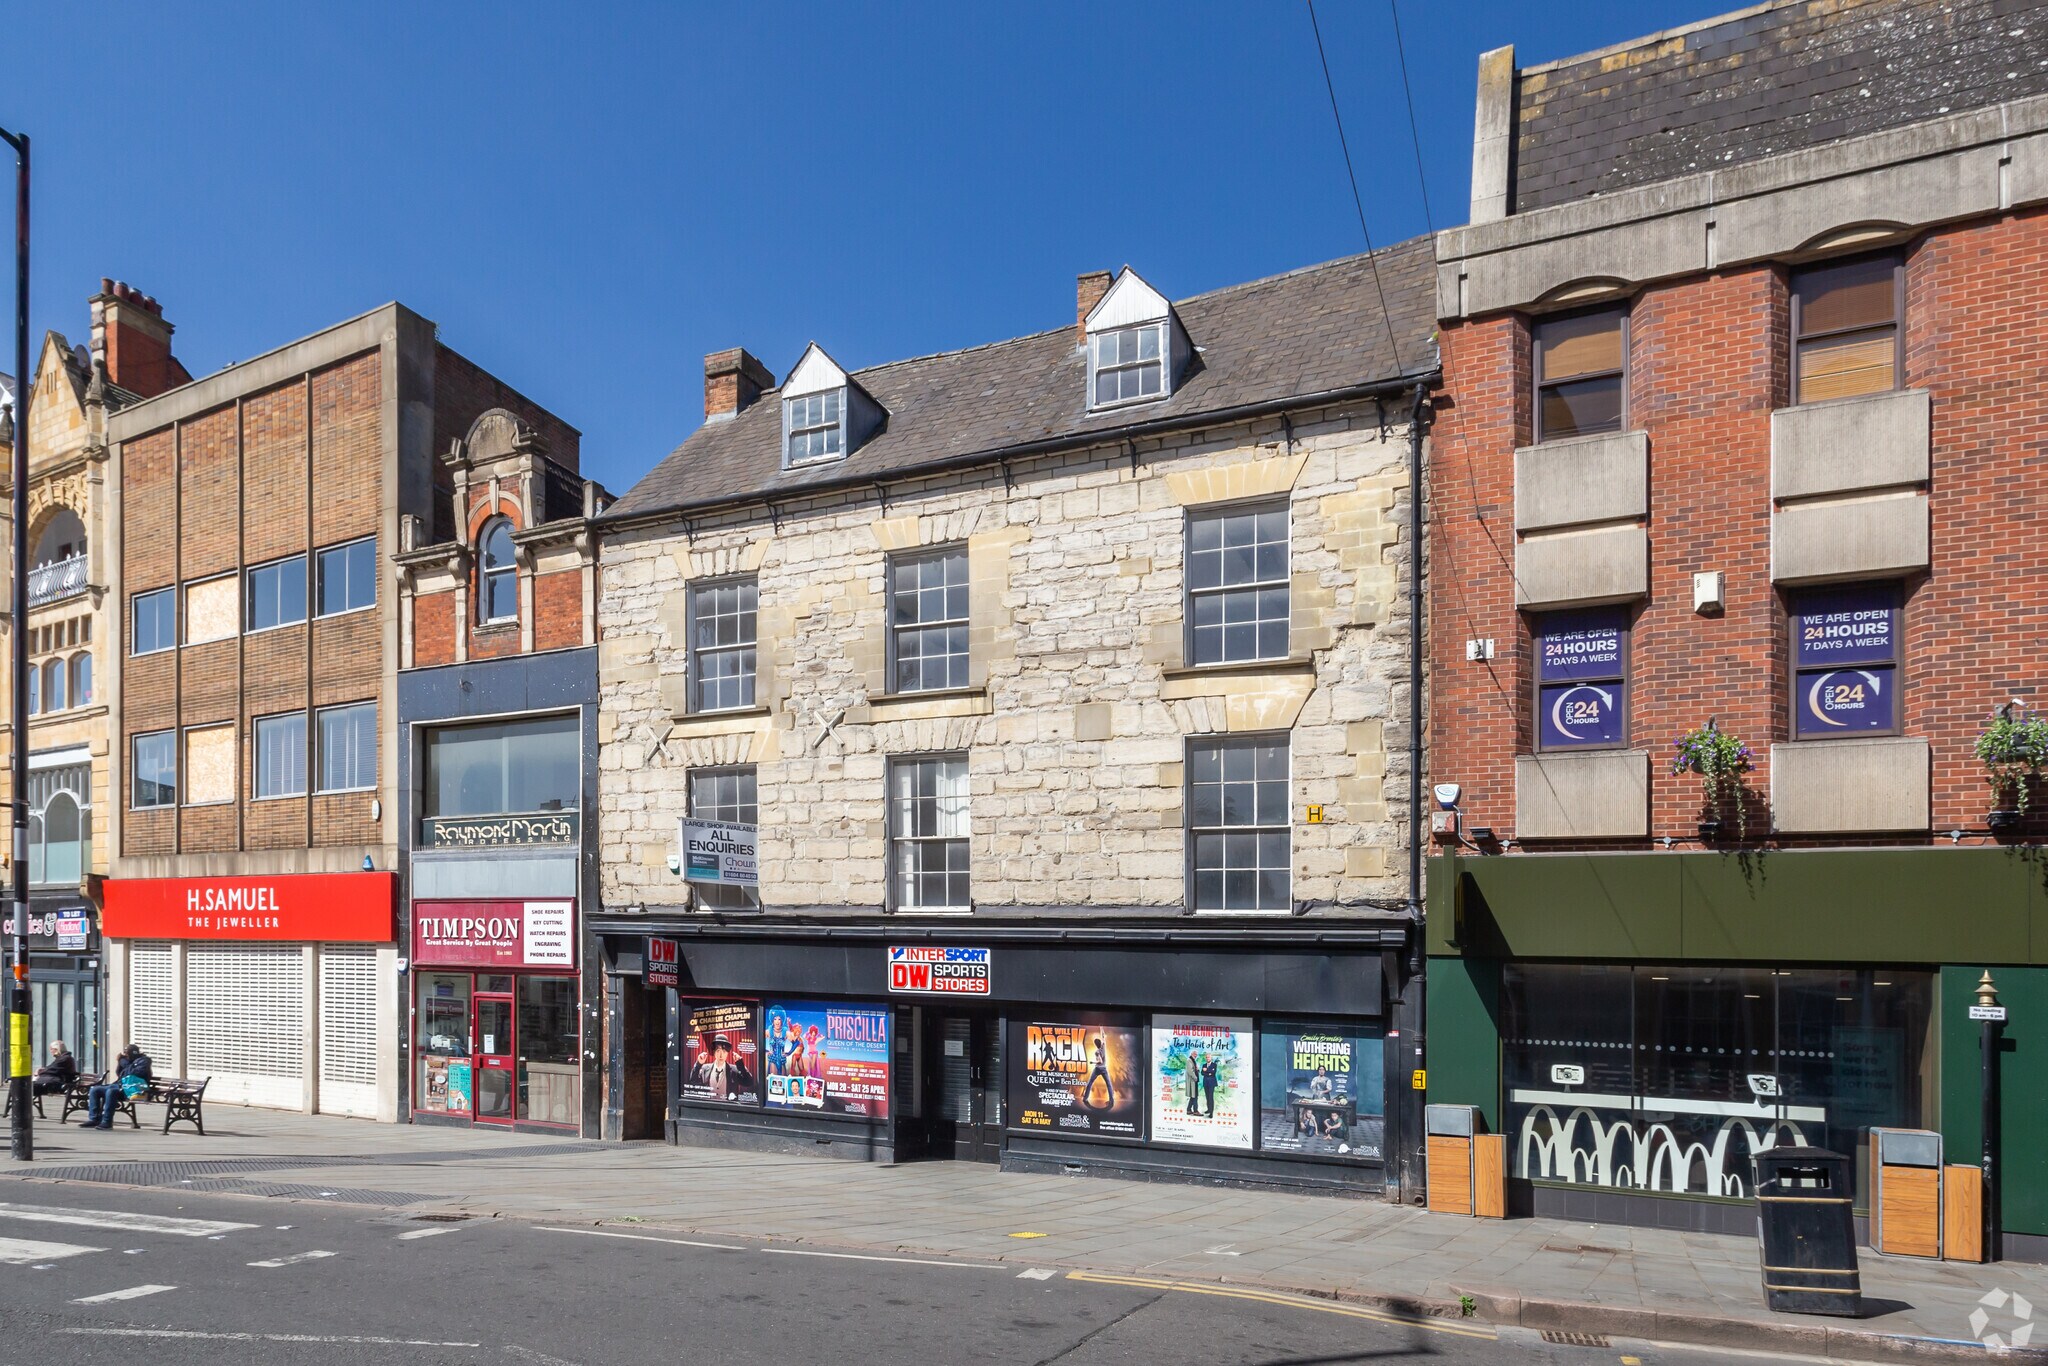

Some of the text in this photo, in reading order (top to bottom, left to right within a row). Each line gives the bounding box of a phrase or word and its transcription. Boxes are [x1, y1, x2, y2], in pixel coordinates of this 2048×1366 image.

[1803, 609, 1889, 625] WE ARE OPEN
[1545, 628, 1617, 642] WE ARE OPEN
[1804, 621, 1889, 640] 24 HOURS
[1546, 639, 1617, 656] 24 HOURS
[1804, 636, 1889, 651] 7 DAYS A WEEK
[1546, 652, 1617, 666] 7 DAYS A WEEK
[1825, 686, 1835, 710] OPEN
[1835, 684, 1865, 703] 24
[1574, 701, 1599, 718] 24
[1834, 702, 1865, 710] HOURS
[1565, 702, 1574, 725] OPEN
[1573, 717, 1600, 725] HOURS
[1308, 806, 1321, 822] H
[434, 817, 571, 844] Raymond Martin
[711, 830, 735, 842] ALL
[726, 825, 757, 833] AVAILABLE
[435, 835, 571, 846] HAIRDRESSING
[689, 840, 755, 856] ENQUIRIES
[725, 857, 756, 868] Chown
[187, 887, 280, 911] H.SAMUEL
[187, 917, 279, 930] THE JEWELLER
[419, 918, 520, 939] TIMPSON
[651, 938, 676, 962] DW
[906, 947, 988, 962] INTERSPORT
[649, 963, 679, 974] SPORTS
[934, 964, 986, 978] SPORTS
[649, 973, 678, 985] STORES
[893, 964, 930, 990] DW
[935, 978, 985, 992] STORES
[699, 1015, 724, 1024] CHARLIE
[724, 1012, 751, 1022] CHAPLIN
[705, 1007, 732, 1017] STRANGE
[694, 1020, 747, 1033] AND STAN LAUREL
[827, 1015, 887, 1043] PRISCILLA
[1042, 1027, 1070, 1035] WE WILL
[1173, 1024, 1230, 1038] ALAN BENNETT'S
[1027, 1026, 1088, 1070] ROCK
[1172, 1037, 1230, 1051] The Habit of Art
[1293, 1040, 1351, 1056] WUTHERING
[1057, 1060, 1088, 1073] YOU
[1293, 1053, 1350, 1073] HEIGHTS
[1841, 1067, 1887, 1078] closed
[1027, 1075, 1055, 1087] QUEEN
[1864, 1082, 1893, 1090] now
[827, 1082, 839, 1091] MON
[851, 1084, 861, 1093] SAT
[862, 1085, 870, 1094] 25
[870, 1085, 886, 1095] APRIL
